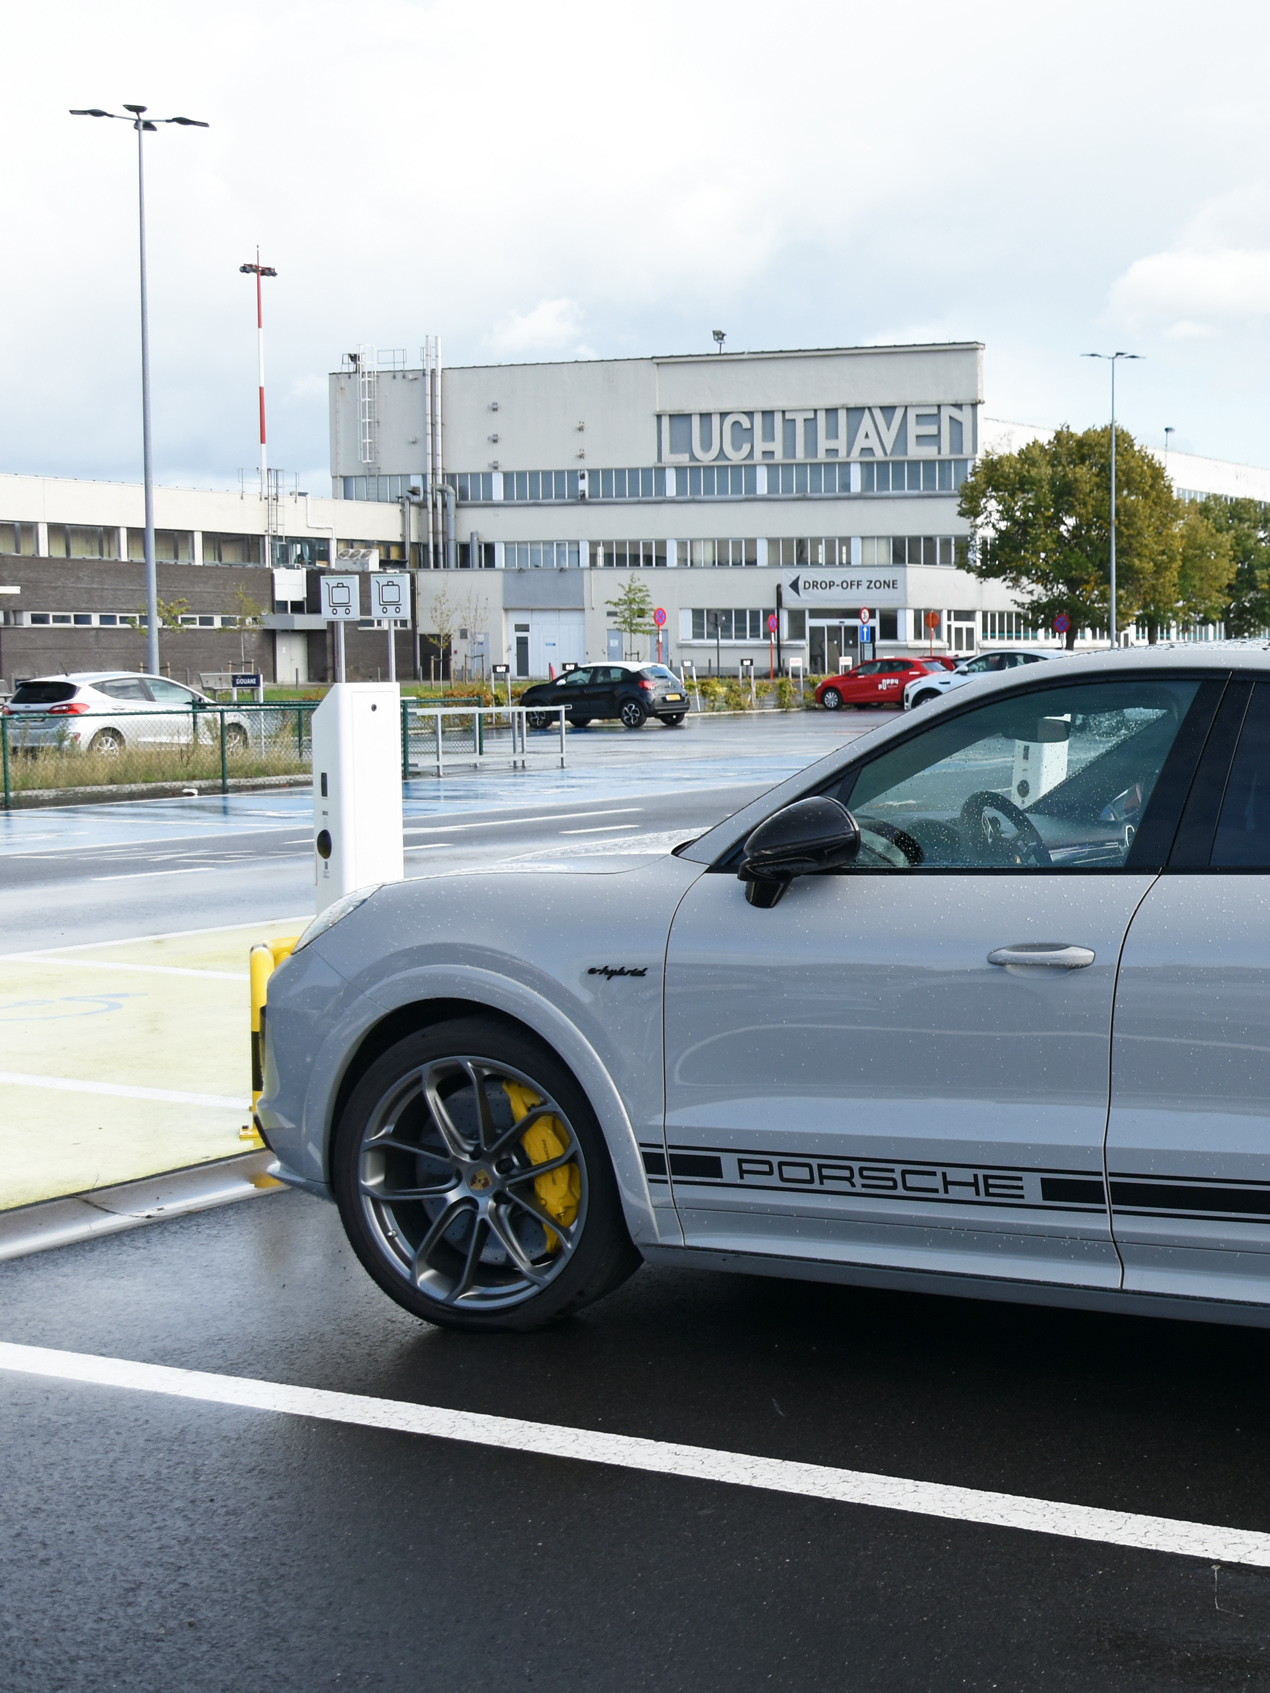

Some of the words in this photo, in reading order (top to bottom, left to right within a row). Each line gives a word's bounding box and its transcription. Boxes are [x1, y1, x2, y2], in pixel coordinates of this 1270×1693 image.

[661, 404, 972, 463] LUCHTHAVEN
[803, 580, 863, 590] DROP-OFF
[866, 579, 898, 590] ZONE
[737, 1157, 1025, 1200] PORSCHE
